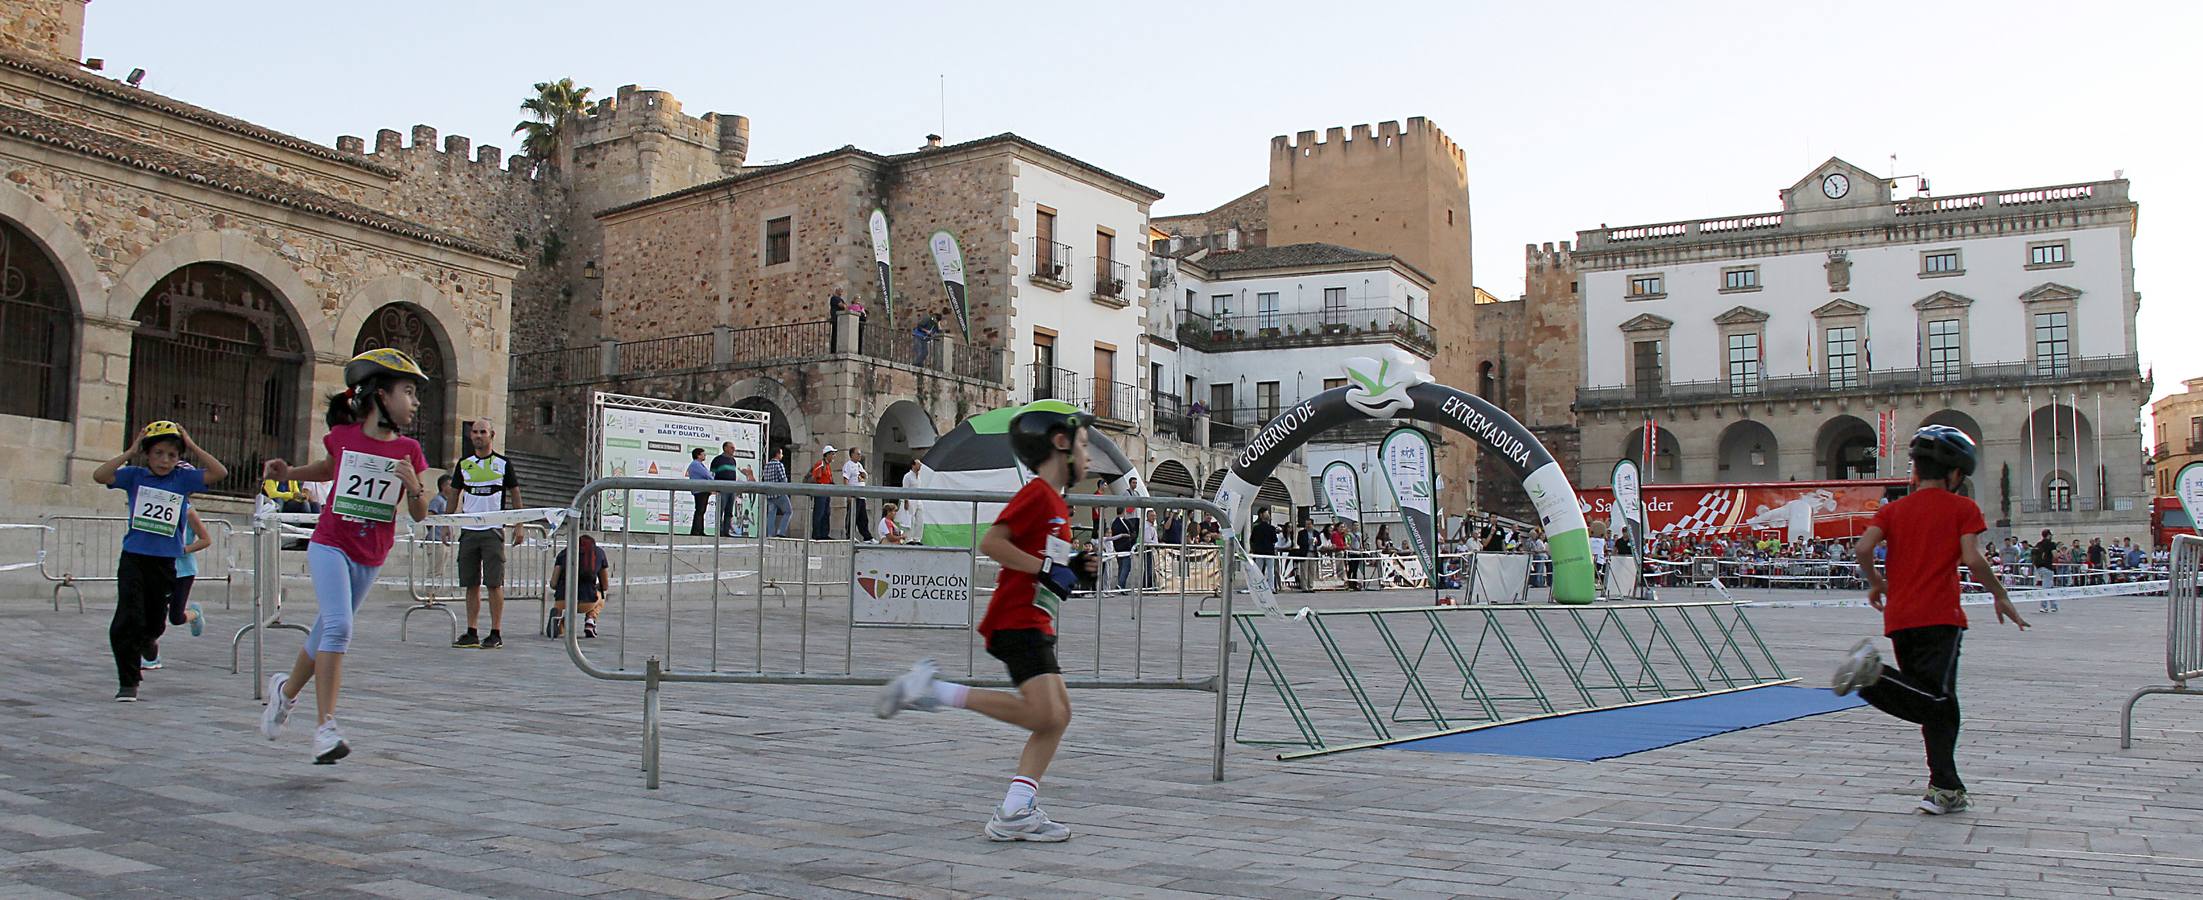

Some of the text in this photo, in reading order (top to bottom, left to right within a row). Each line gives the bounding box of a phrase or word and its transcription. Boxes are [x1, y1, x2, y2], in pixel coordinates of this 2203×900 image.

[671, 424, 705, 432] CIRCUITO
[1239, 400, 1316, 468] GOBIERNO DE
[1441, 395, 1531, 467] EXTREMADURA
[346, 474, 391, 500] 217
[142, 502, 173, 522] 226
[1595, 496, 1674, 513] Sader
[892, 573, 968, 587] DIPUTACIÓN
[892, 587, 968, 600] DE CÁCERES
